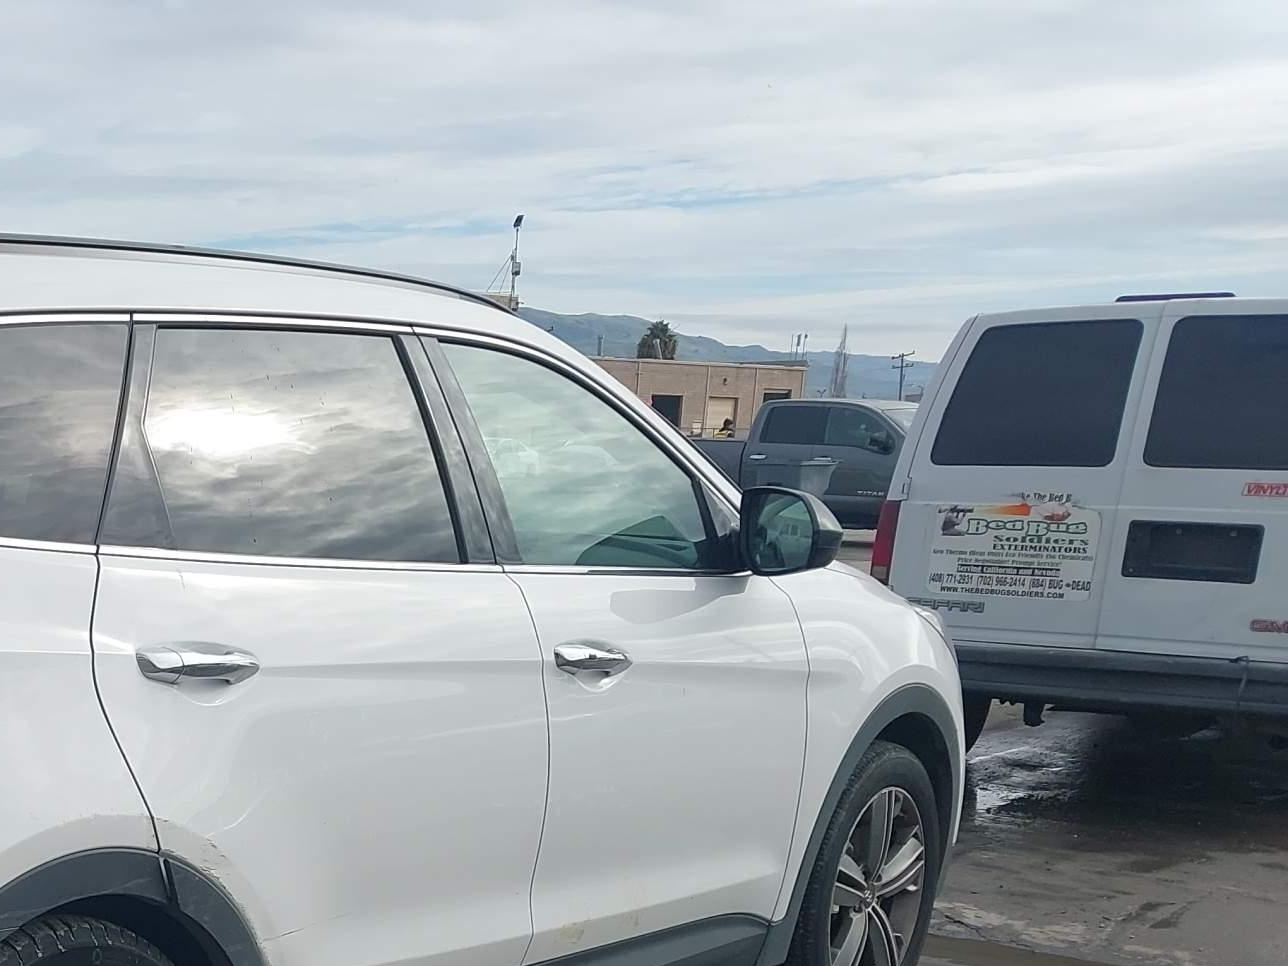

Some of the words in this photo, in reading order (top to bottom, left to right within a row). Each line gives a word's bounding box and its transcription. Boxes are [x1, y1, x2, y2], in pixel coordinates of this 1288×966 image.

[965, 518, 1025, 535] Bed
[1026, 521, 1088, 537] Bug
[993, 535, 1089, 546] Soldiers
[993, 543, 1088, 554] EXTERMINATORS
[977, 575, 993, 587] (702)
[1048, 580, 1063, 590] BUG
[940, 586, 1064, 599] WWW.THEBEDBUGSOLDIERS.COM
